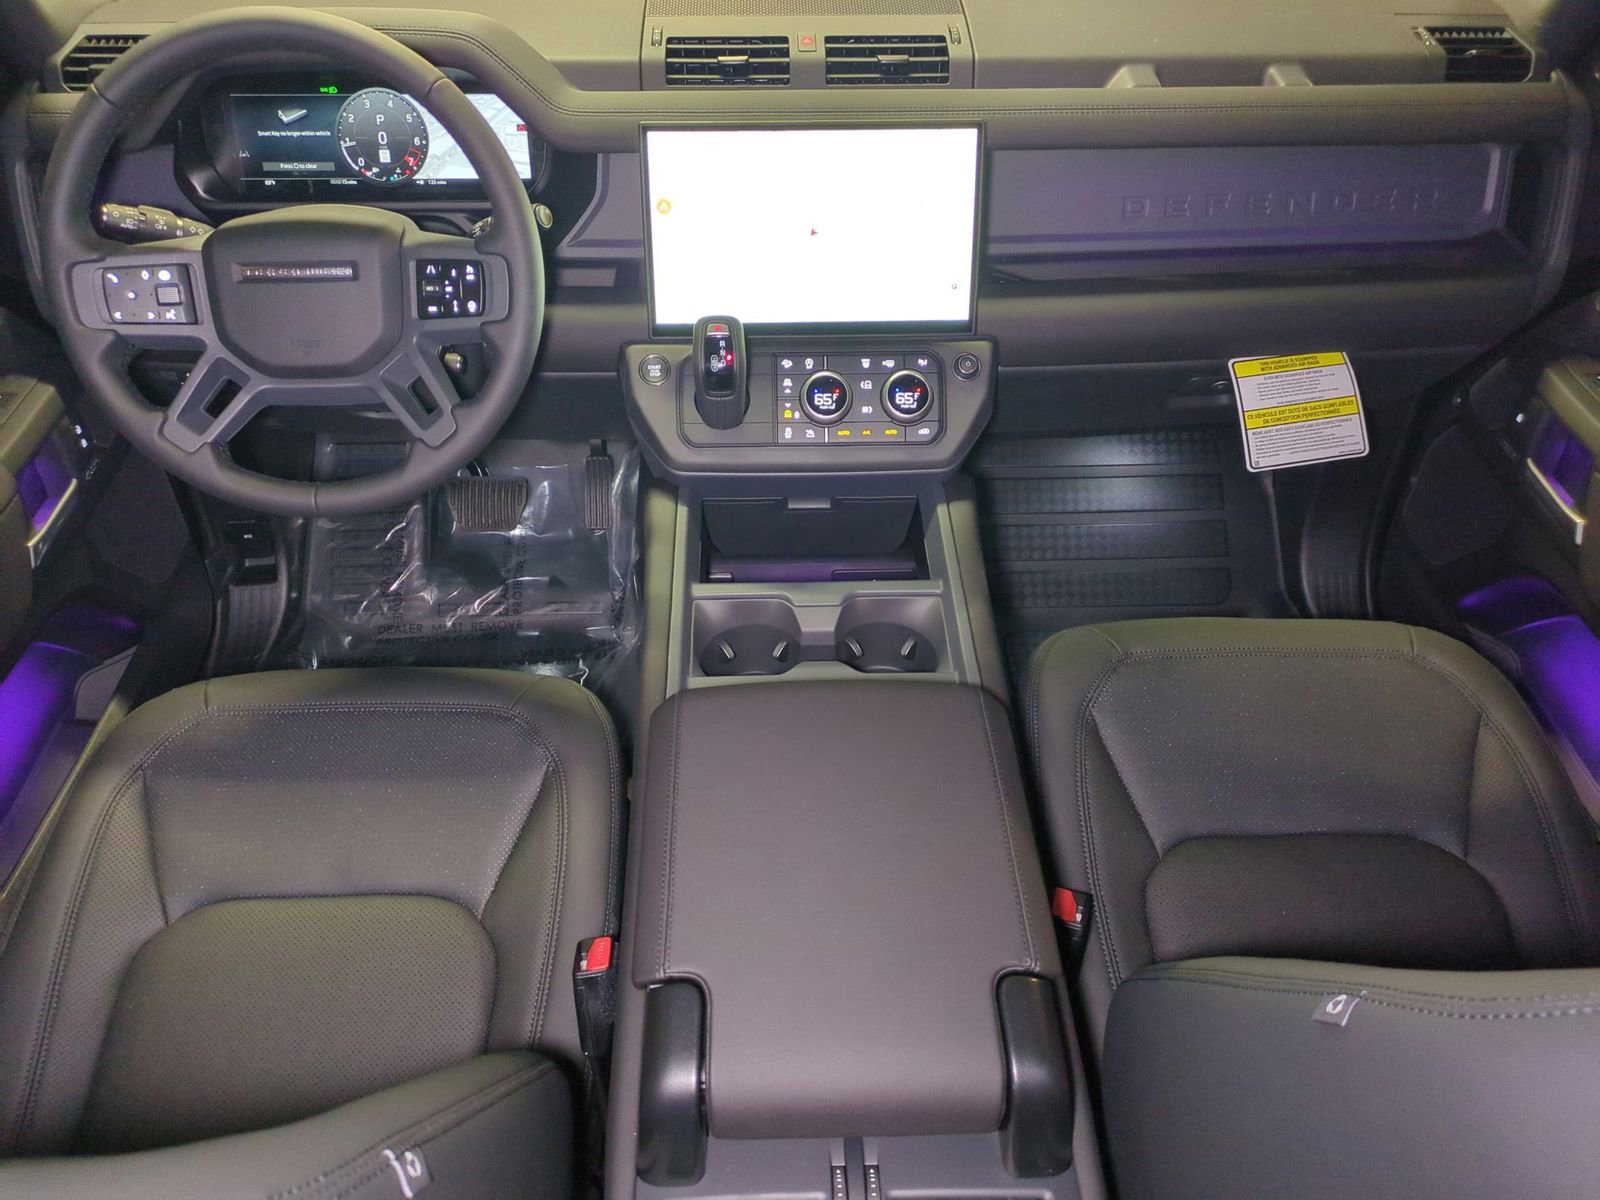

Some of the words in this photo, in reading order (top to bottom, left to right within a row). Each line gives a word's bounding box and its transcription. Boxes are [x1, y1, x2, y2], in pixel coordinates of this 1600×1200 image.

[364, 100, 370, 108] 3
[387, 100, 393, 108] 4
[348, 114, 354, 122] 2
[376, 114, 384, 125] P
[406, 114, 412, 122] 5
[378, 131, 387, 145] 0
[414, 137, 420, 145] 6
[358, 157, 365, 166] 0
[1255, 410, 1277, 419] VÉHICULE
[1323, 400, 1354, 409] GONFLABLES
[1271, 414, 1300, 423] CONCEPTION
[377, 624, 423, 635] DEALER
[472, 620, 524, 631] REMOVE
